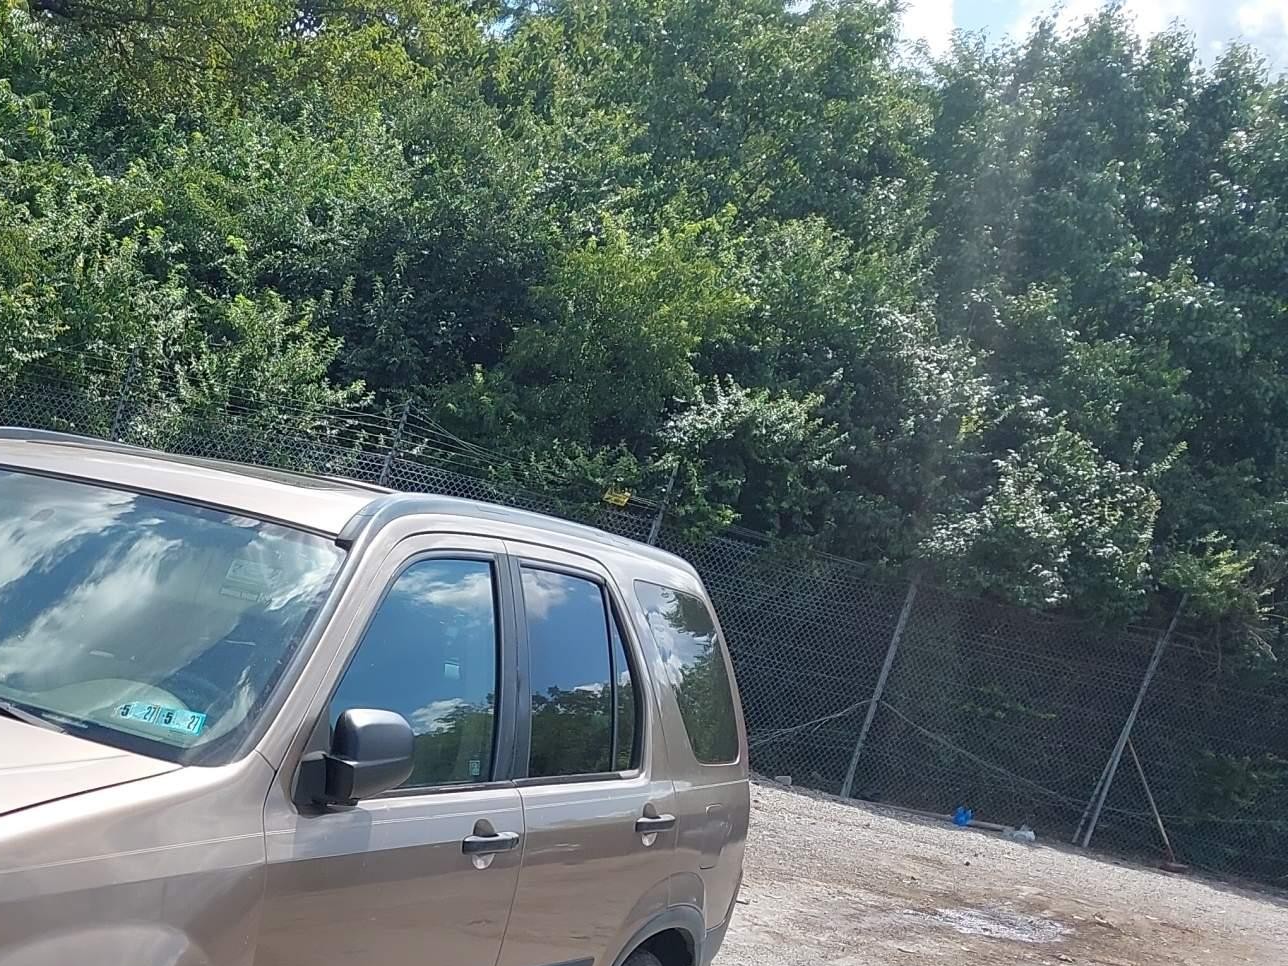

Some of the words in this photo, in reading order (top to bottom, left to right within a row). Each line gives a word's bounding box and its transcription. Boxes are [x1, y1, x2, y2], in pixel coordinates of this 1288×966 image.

[121, 704, 131, 717] 5
[143, 705, 157, 721] 27
[164, 712, 174, 725] 5
[187, 714, 201, 730] 27
